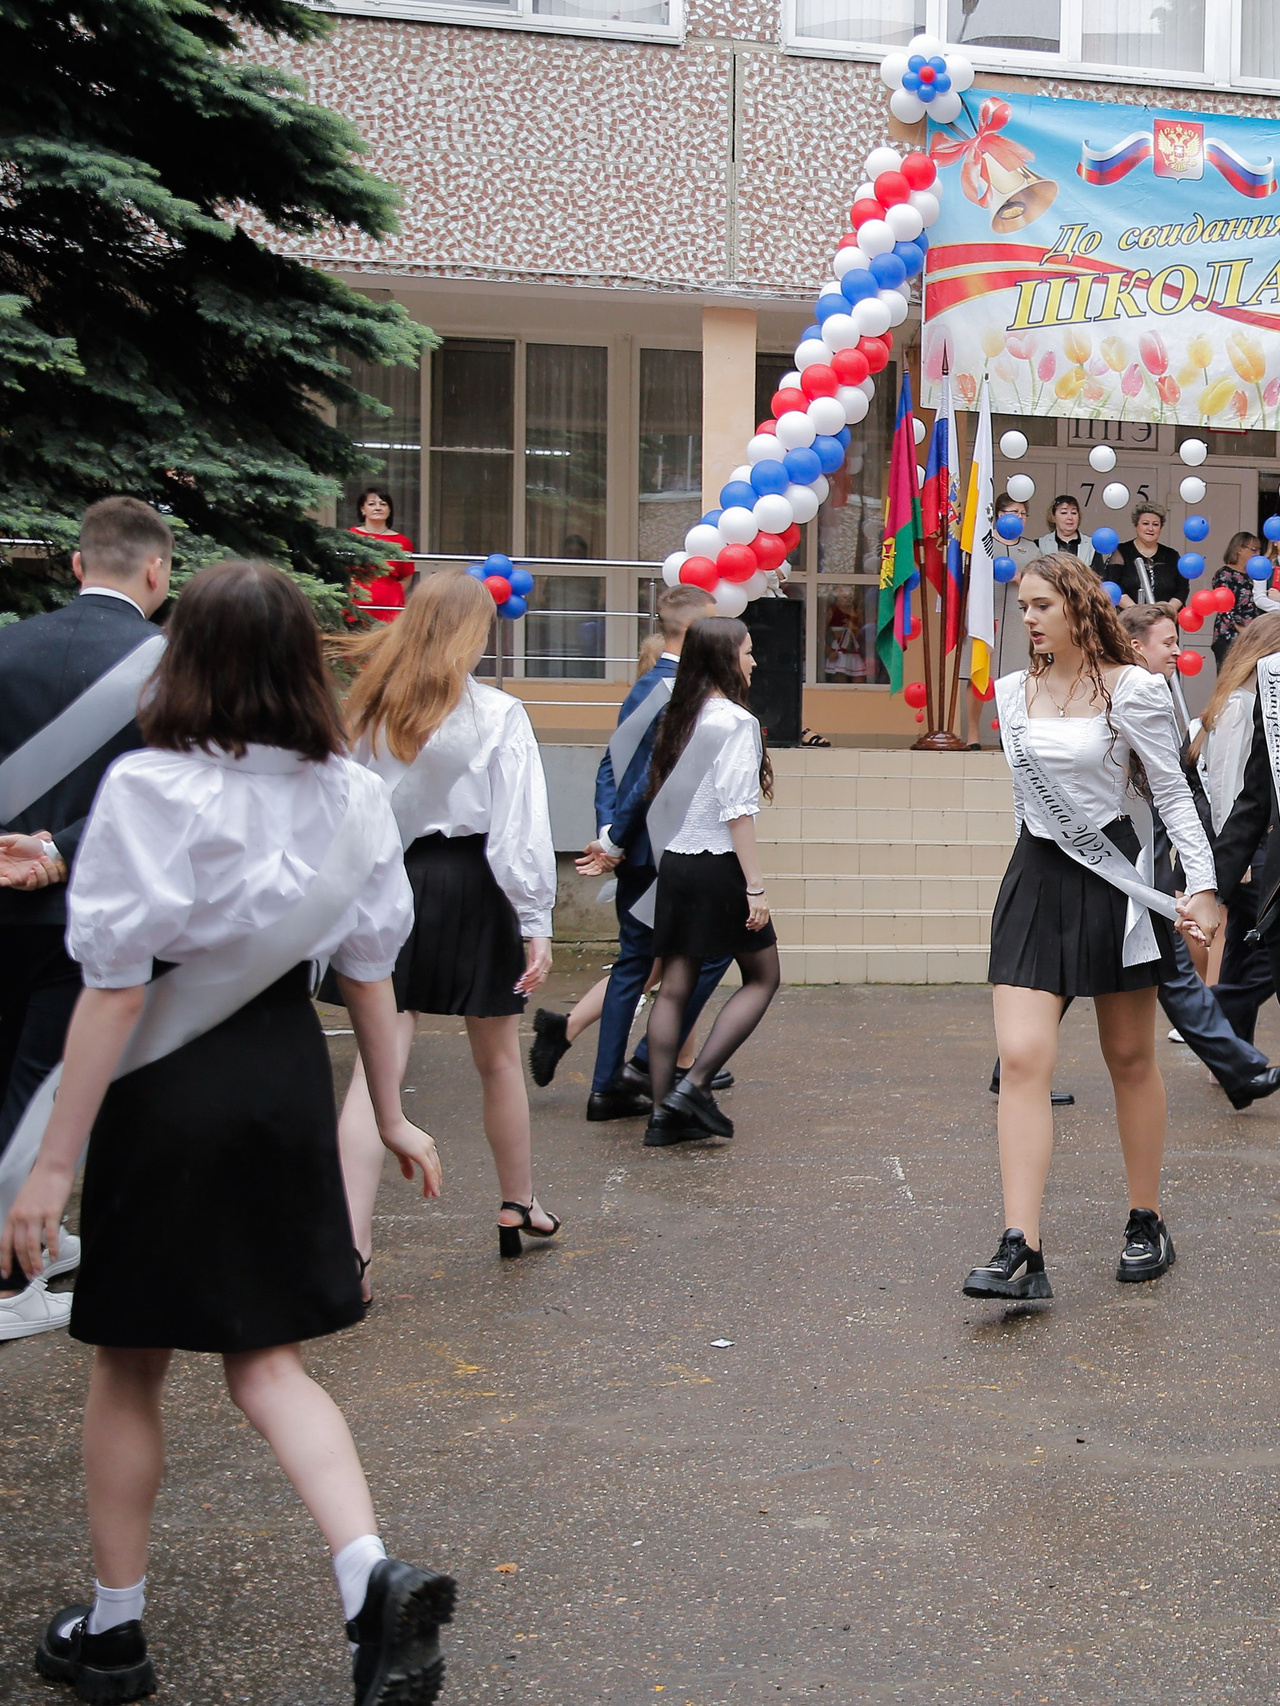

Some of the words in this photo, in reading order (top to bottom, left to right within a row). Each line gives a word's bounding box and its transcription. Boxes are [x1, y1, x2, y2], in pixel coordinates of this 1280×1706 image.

[1039, 222, 1103, 266] До
[1010, 709, 1073, 827] Выпускница
[1061, 824, 1113, 866] 2023
